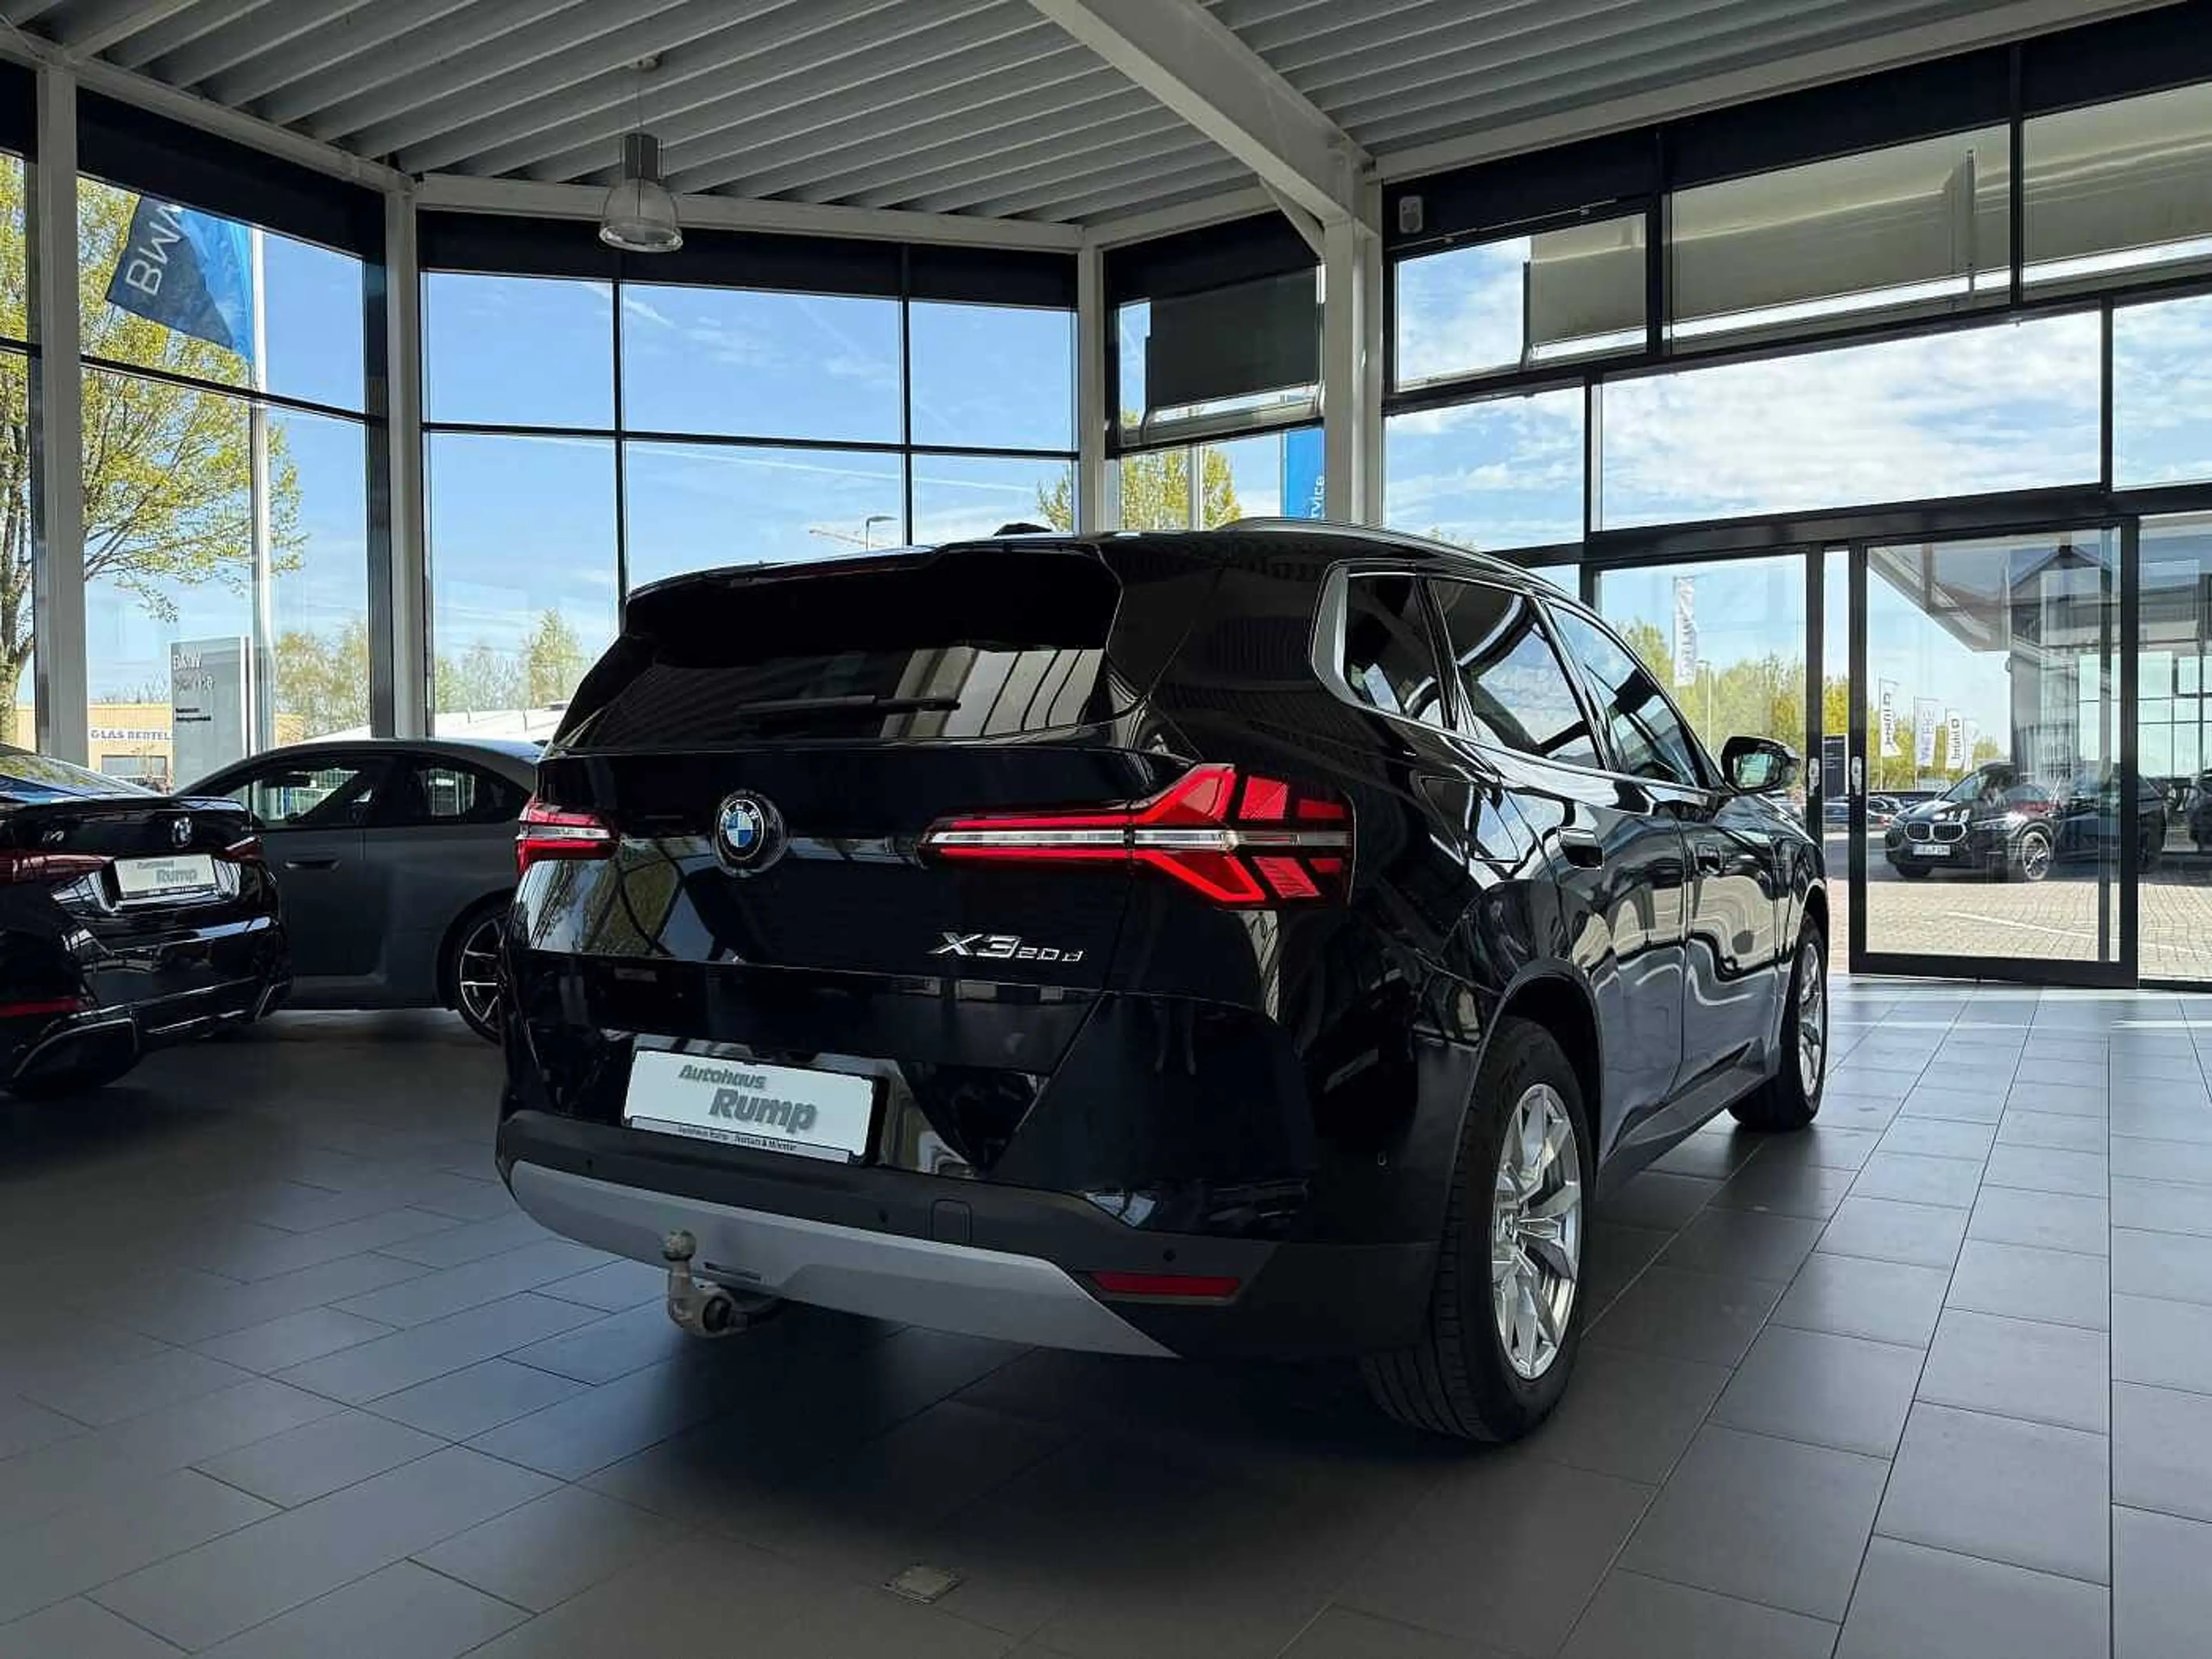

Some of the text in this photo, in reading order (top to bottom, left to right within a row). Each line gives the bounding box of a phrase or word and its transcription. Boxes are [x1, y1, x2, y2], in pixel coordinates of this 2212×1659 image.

[90, 730, 124, 739] GLAS
[679, 1064, 767, 1090] Autohaus
[709, 1087, 817, 1134] Rump
